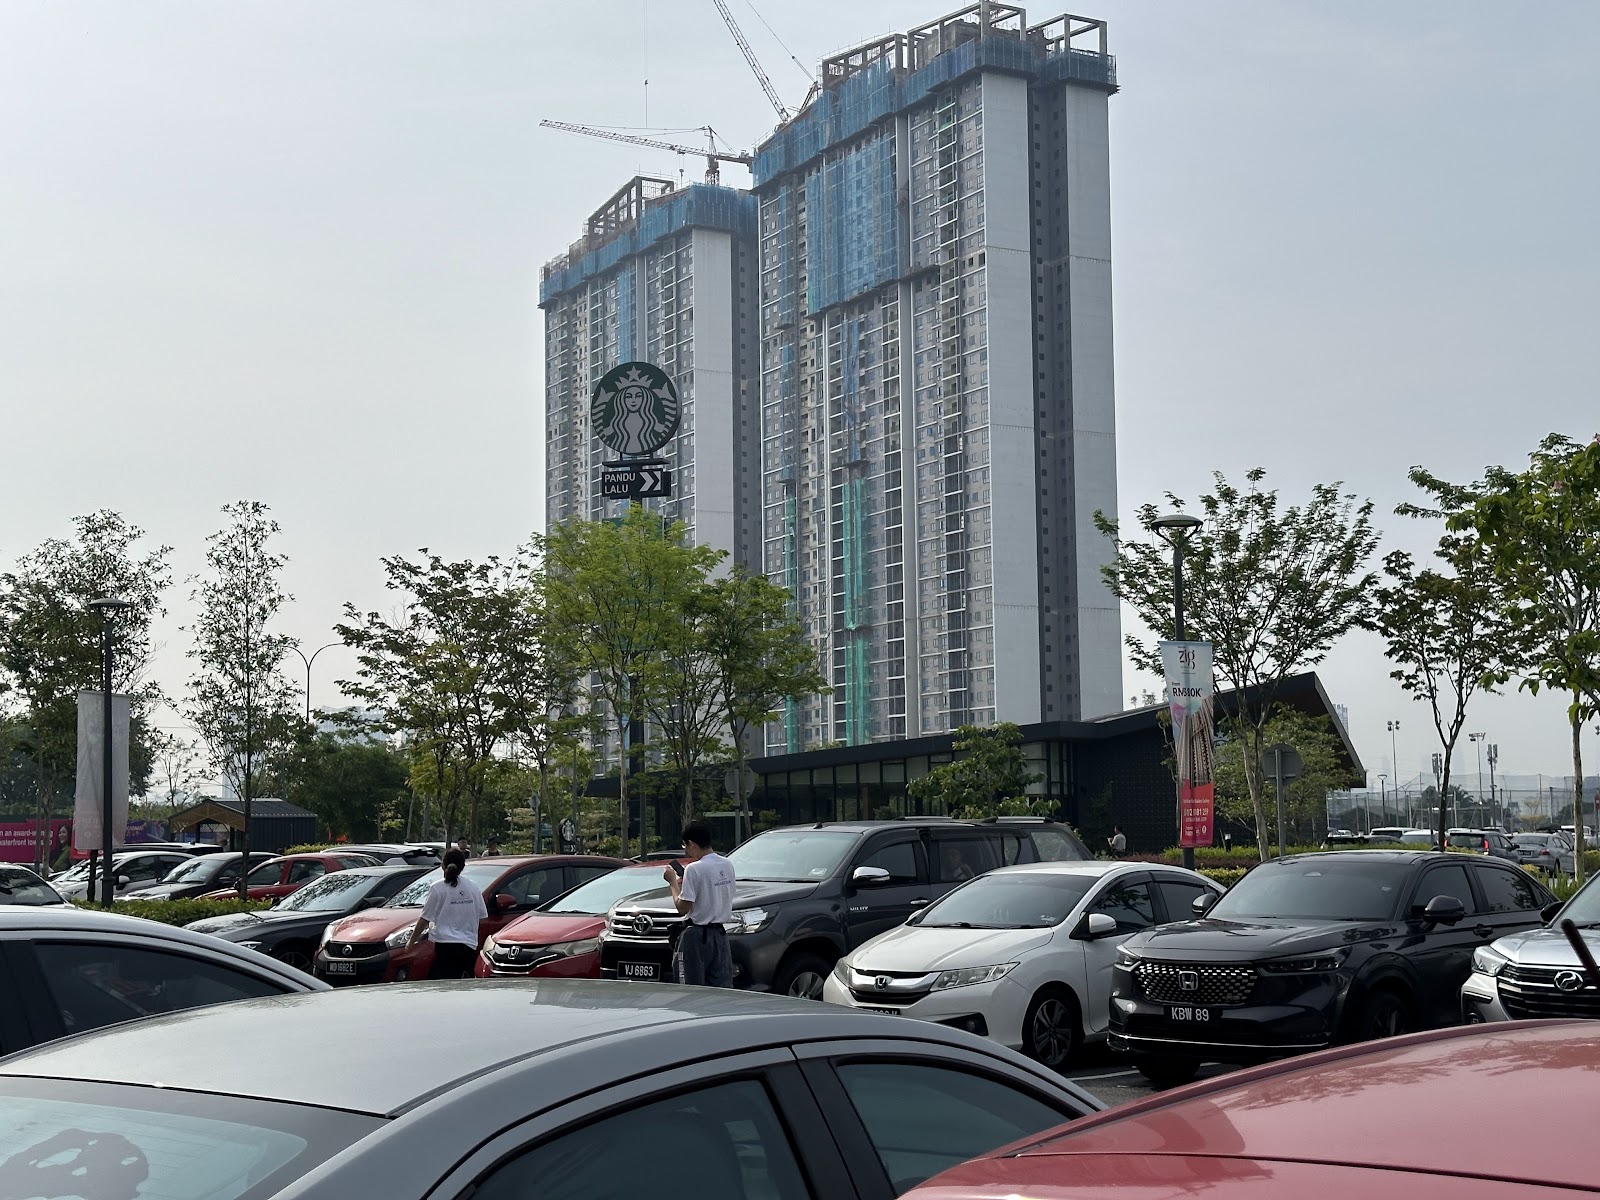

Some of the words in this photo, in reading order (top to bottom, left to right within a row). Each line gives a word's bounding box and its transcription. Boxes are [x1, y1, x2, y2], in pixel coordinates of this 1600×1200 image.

[604, 472, 636, 483] PANDU
[604, 484, 629, 494] LALU
[625, 964, 634, 976] VJ
[634, 965, 654, 977] 6863
[1171, 1007, 1192, 1020] KBW
[1195, 1008, 1210, 1021] 89
